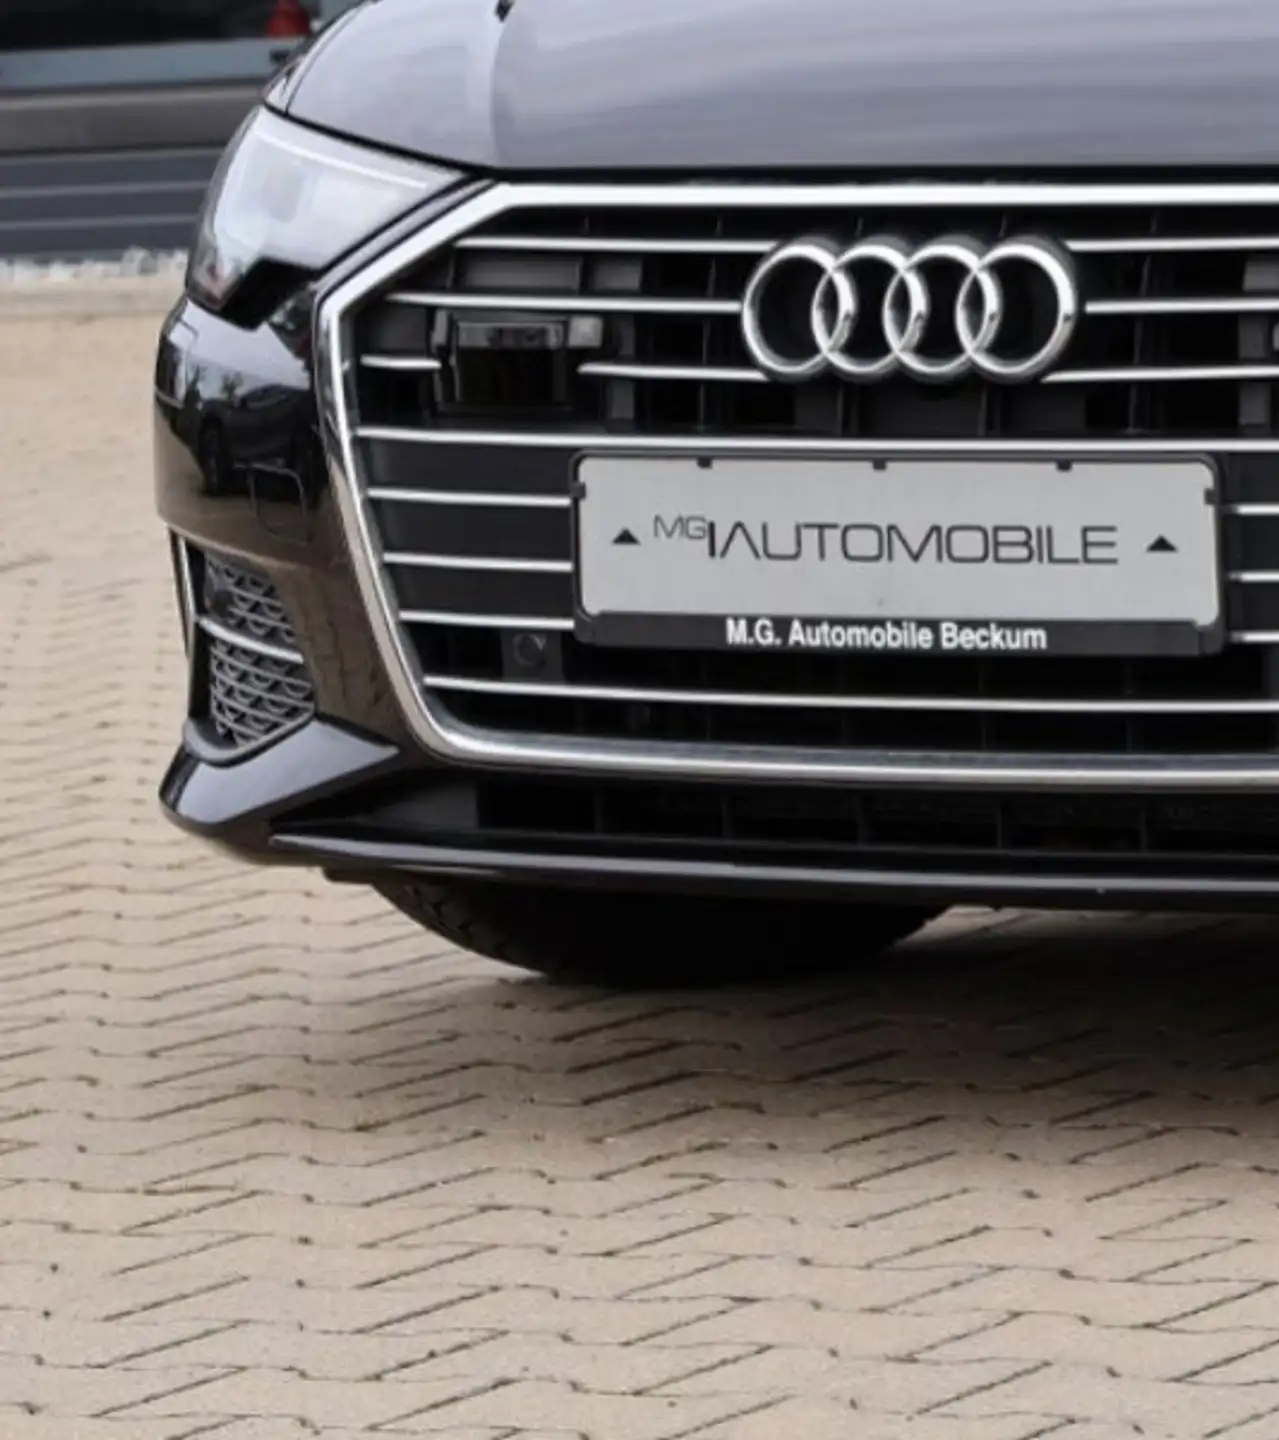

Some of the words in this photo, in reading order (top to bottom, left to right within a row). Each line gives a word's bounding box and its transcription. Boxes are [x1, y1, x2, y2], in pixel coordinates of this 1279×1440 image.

[725, 616, 782, 646] M.G.
[788, 617, 934, 650] Automobile
[940, 620, 1048, 650] Beckum
